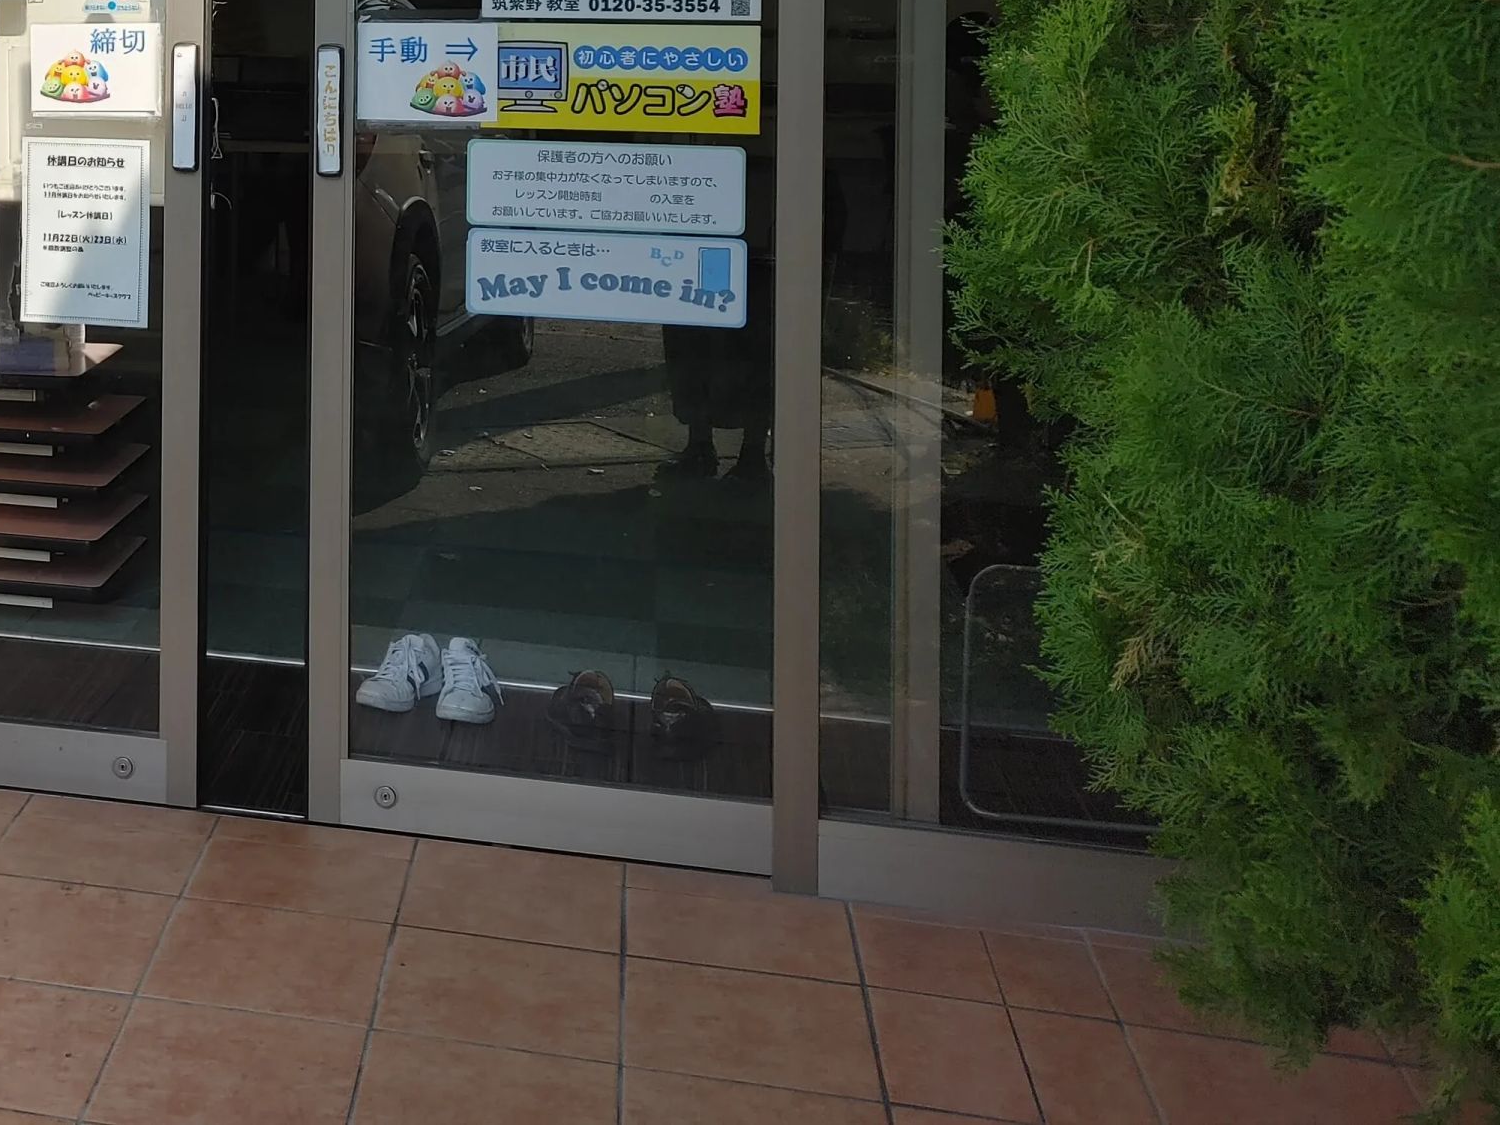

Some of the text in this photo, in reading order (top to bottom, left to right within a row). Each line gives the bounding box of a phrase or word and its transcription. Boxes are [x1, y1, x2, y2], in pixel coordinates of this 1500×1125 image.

[90, 28, 145, 55] 締切
[368, 35, 428, 63] 手動
[501, 54, 558, 83] 市民
[577, 49, 745, 69] 初心者にやさしい
[571, 78, 749, 118] パソコン塾
[47, 155, 126, 169] 休講日のお知らせ
[537, 150, 672, 167] 保護者の方へのお願い
[492, 170, 720, 188] お子様の集中力がなくなってしまいますので、
[515, 189, 695, 205] レッスン開始時刻 の入室を
[476, 266, 737, 313] May I come in?
